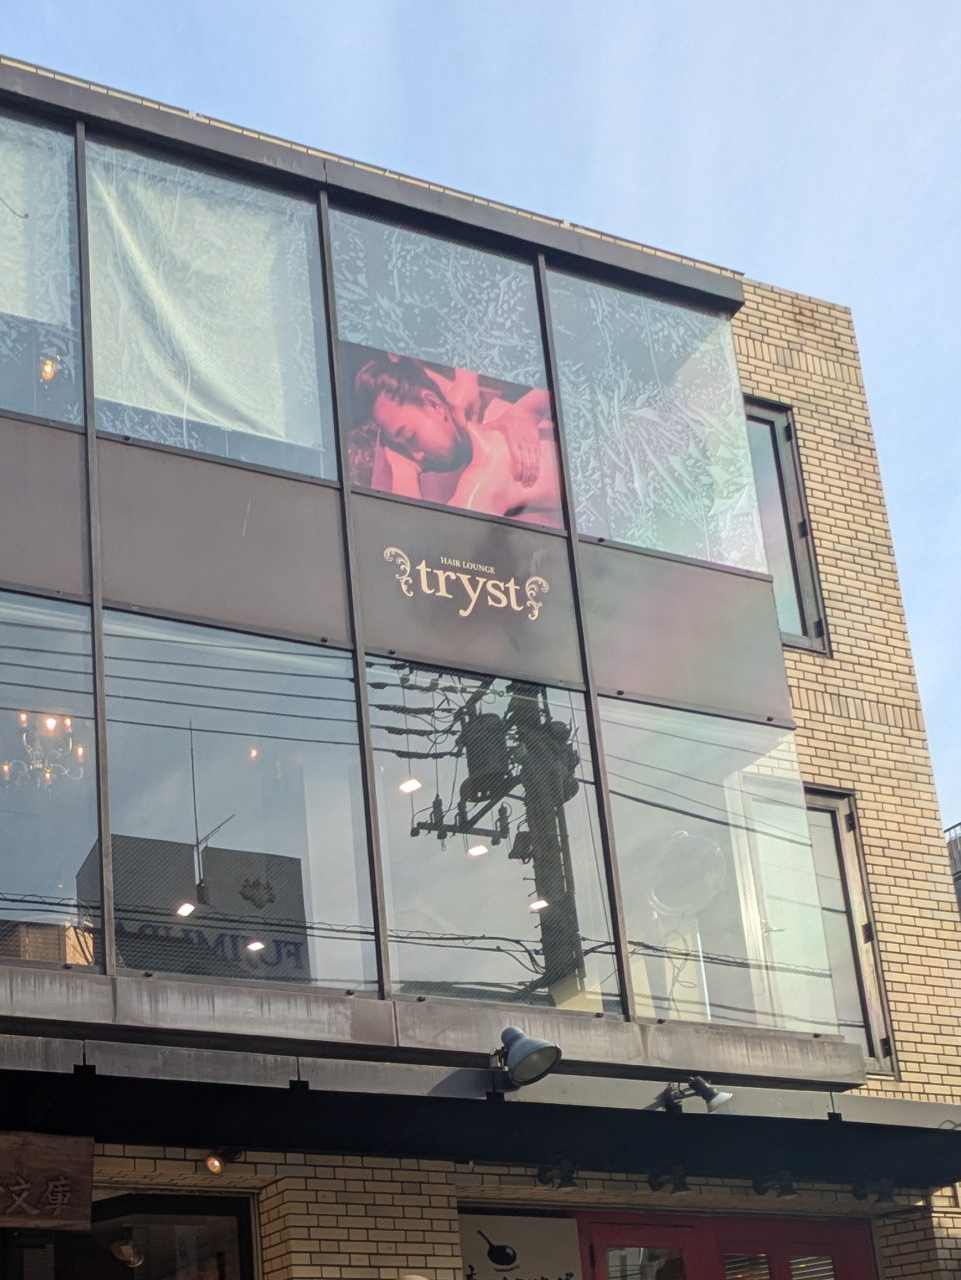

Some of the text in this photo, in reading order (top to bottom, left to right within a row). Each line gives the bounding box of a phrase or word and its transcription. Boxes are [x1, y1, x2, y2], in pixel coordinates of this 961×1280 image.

[440, 556, 496, 574] HAIR LOUNGE
[415, 559, 525, 617] tryst
